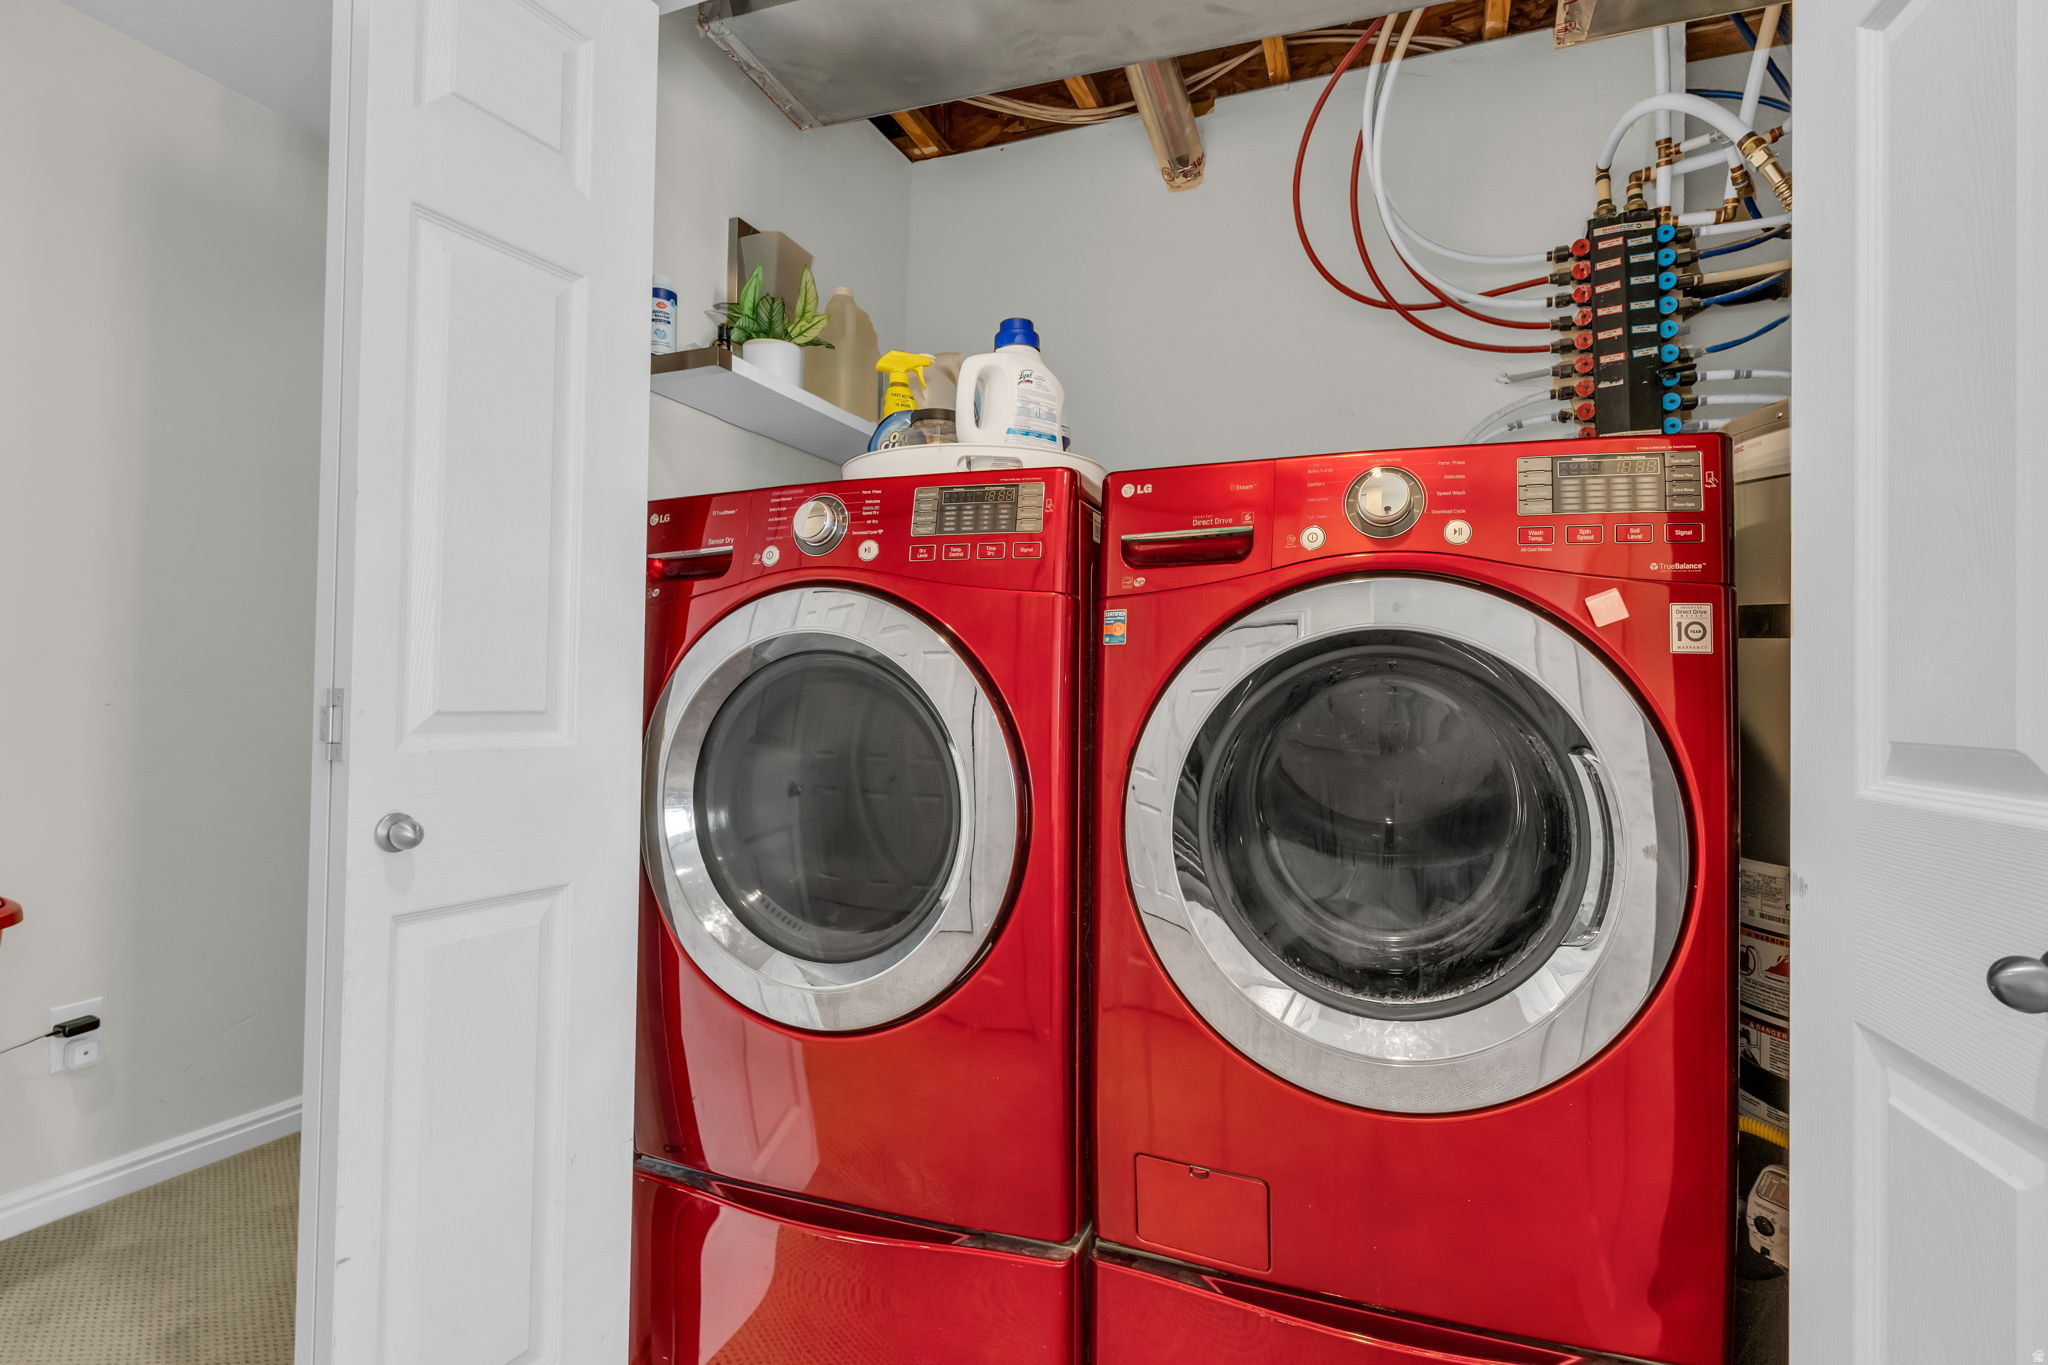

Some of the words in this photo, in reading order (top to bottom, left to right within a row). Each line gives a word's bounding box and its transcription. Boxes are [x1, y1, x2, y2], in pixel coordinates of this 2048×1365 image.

[1136, 484, 1152, 494] LG
[659, 513, 671, 524] LG
[1193, 518, 1213, 526] Direct
[1214, 517, 1233, 525] Drive
[1676, 621, 1708, 642] 10
[1756, 1024, 1788, 1040] DANGER
